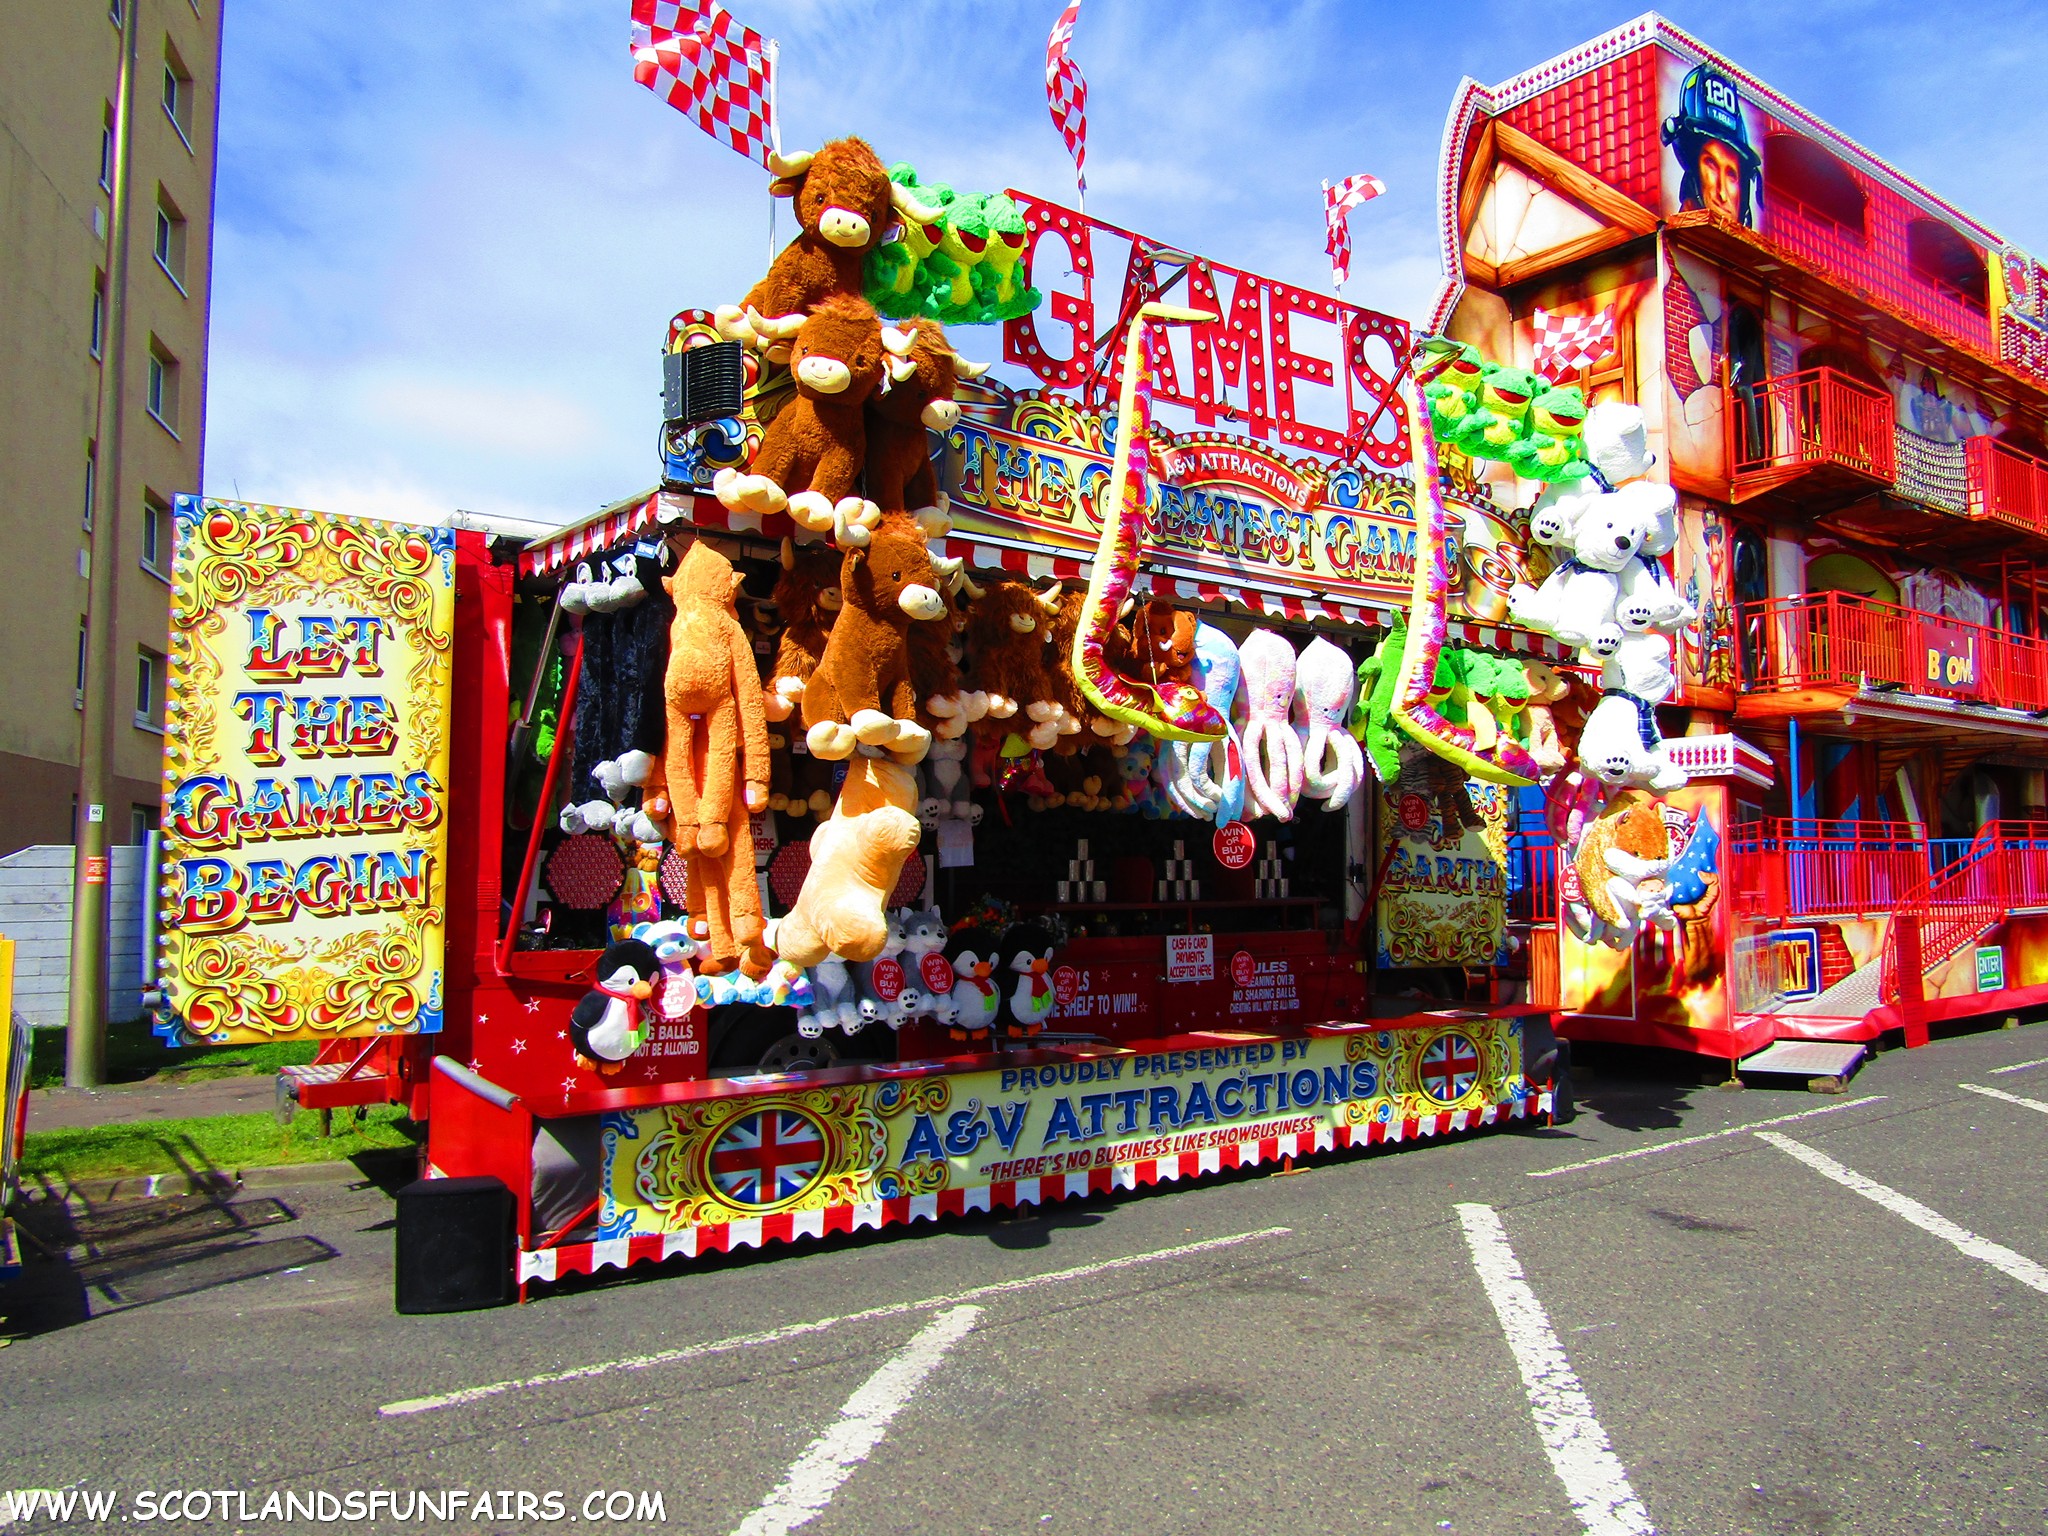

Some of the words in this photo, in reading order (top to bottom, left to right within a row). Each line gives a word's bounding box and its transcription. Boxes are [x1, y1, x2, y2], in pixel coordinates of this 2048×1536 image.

[1705, 79, 1735, 114] 120
[1016, 201, 1410, 468] GAMES
[1166, 455, 1195, 480] A&V
[1199, 453, 1307, 507] ATTRACTIONS
[948, 422, 1076, 522] THE
[1325, 514, 1462, 588] GAMS
[241, 608, 394, 684] LET
[231, 690, 399, 767] THE
[1403, 798, 1419, 807] WIN
[1407, 805, 1416, 813] OR
[169, 770, 443, 851] GAMES
[1405, 812, 1421, 820] BUY
[1408, 818, 1420, 826] ME
[1220, 827, 1244, 837] WIN
[753, 838, 775, 850] HERE
[1226, 836, 1239, 846] OR
[1221, 845, 1245, 854] BUY
[1226, 854, 1244, 863] ME
[1384, 846, 1502, 897] EARTH
[174, 849, 436, 936] BEGIN
[621, 891, 652, 913] TO
[1172, 937, 1187, 950] CASH
[1193, 936, 1208, 949] CARD
[926, 958, 944, 967] WIN
[1176, 951, 1205, 964] PAYMENTS
[880, 964, 898, 973] WIN
[931, 966, 941, 974] OR
[1169, 965, 1196, 978] ACCEPTED
[1197, 964, 1212, 976] HERE
[1979, 956, 2000, 974] ENTER
[929, 973, 946, 982] BUY
[1058, 971, 1073, 979] WIN
[1236, 968, 1249, 976] BUY
[880, 980, 899, 988] BUY
[934, 981, 948, 989] ME
[1057, 985, 1072, 993] BUY
[883, 988, 896, 996] ME
[1233, 990, 1243, 1001] NO
[1245, 988, 1275, 1001] SHARING
[1276, 987, 1296, 999] BALLS
[1097, 994, 1110, 1015] TO
[1113, 993, 1137, 1013] WIN!!
[659, 1024, 694, 1040] BALLS
[652, 1042, 662, 1056] BE
[664, 1041, 699, 1055] ALLOWED
[1001, 1057, 1124, 1094] PROUDLY
[1134, 1043, 1275, 1080] PRESENTED
[1281, 1039, 1312, 1065] BY
[899, 1098, 1031, 1170] A&V
[1041, 1061, 1380, 1151] ATTRACTIONS
[1066, 1149, 1092, 1171] NO
[1095, 1137, 1171, 1166] BUSINESS
[1173, 1133, 1205, 1153] LIKE
